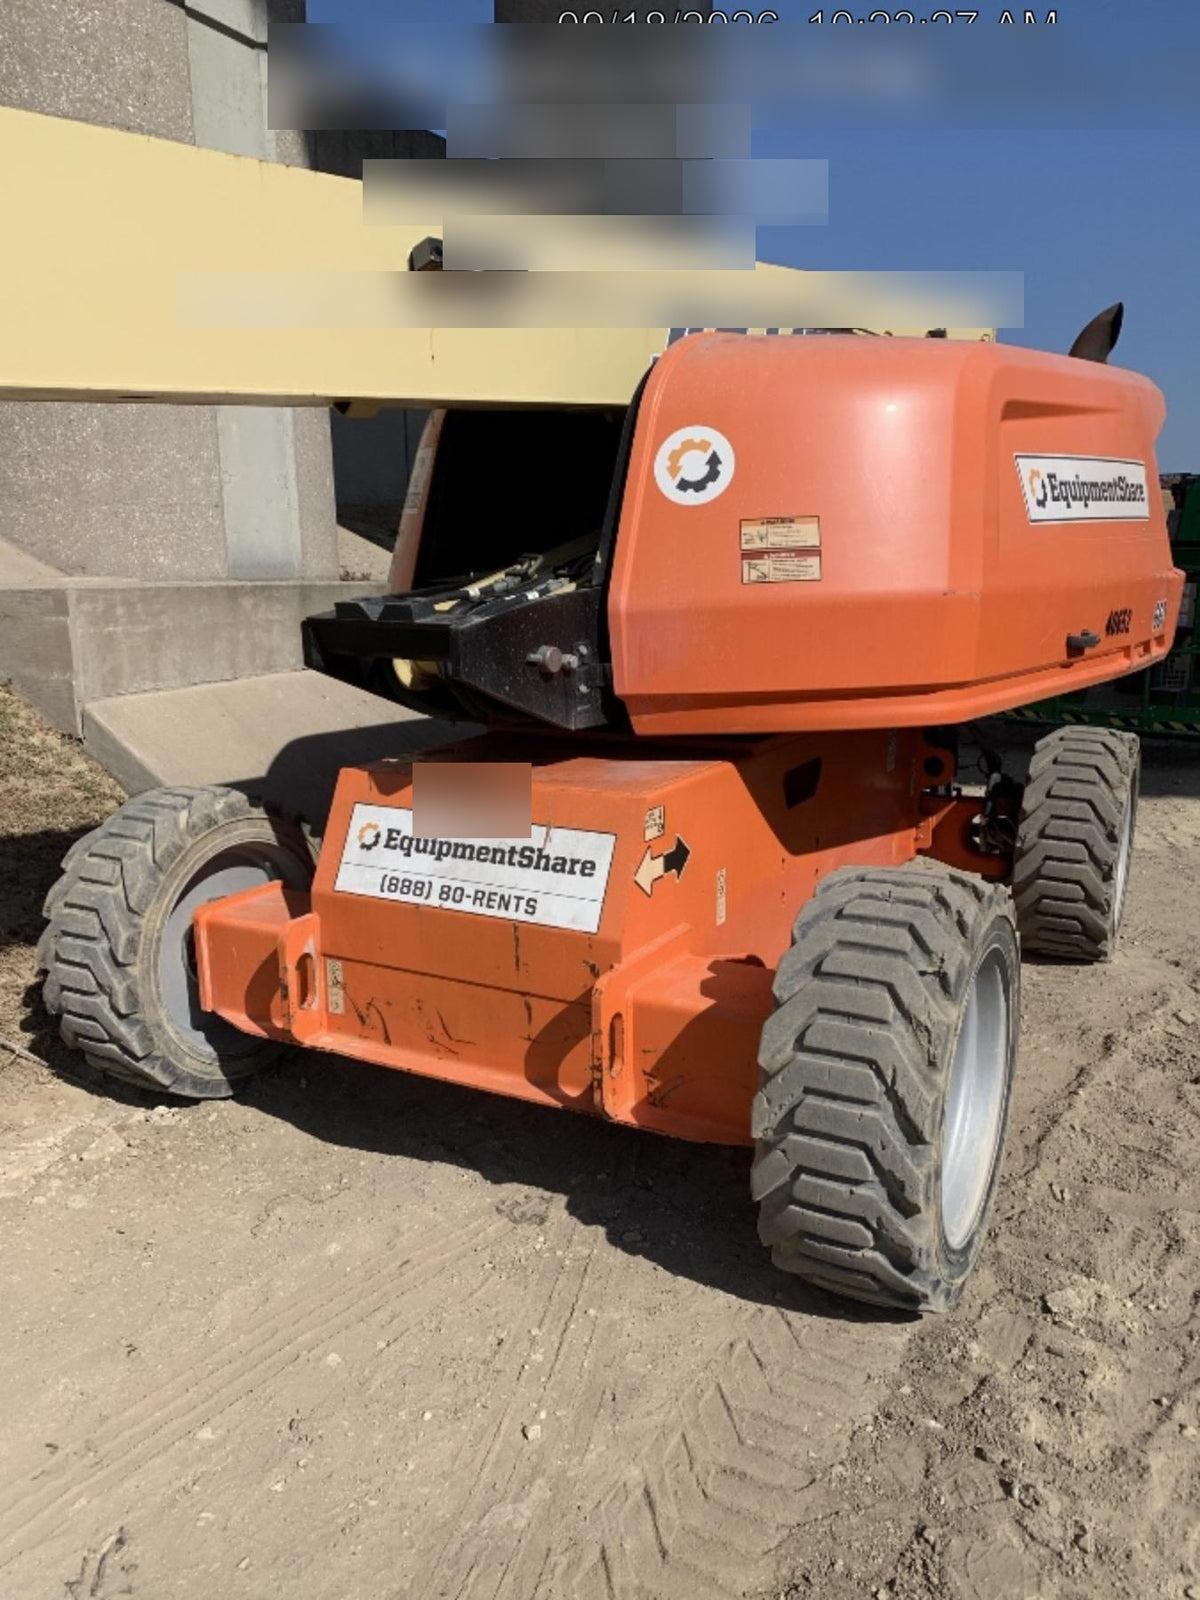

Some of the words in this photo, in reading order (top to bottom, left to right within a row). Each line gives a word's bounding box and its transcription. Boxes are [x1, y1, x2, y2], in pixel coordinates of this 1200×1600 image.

[1047, 472, 1146, 509] EquipmentShare
[383, 827, 597, 877] EquipmentShare
[380, 874, 433, 901] (888)
[438, 884, 538, 917] 80-RENTS
